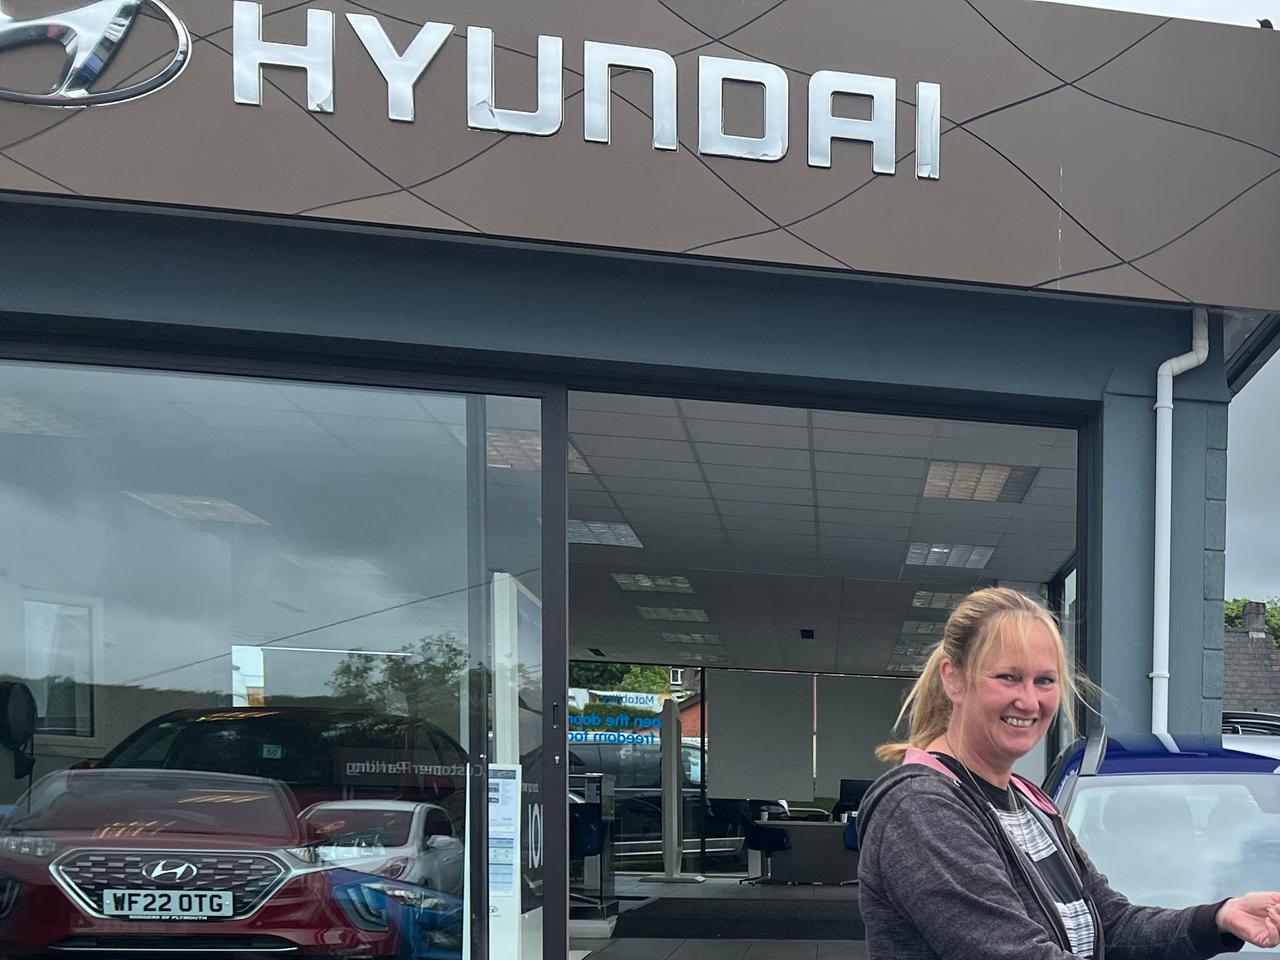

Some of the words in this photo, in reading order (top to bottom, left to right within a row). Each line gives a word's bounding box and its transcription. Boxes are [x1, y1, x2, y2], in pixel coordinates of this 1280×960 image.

[233, 0, 942, 181] HYUNDAI
[112, 892, 172, 912] WF22
[178, 893, 224, 913] OTG
